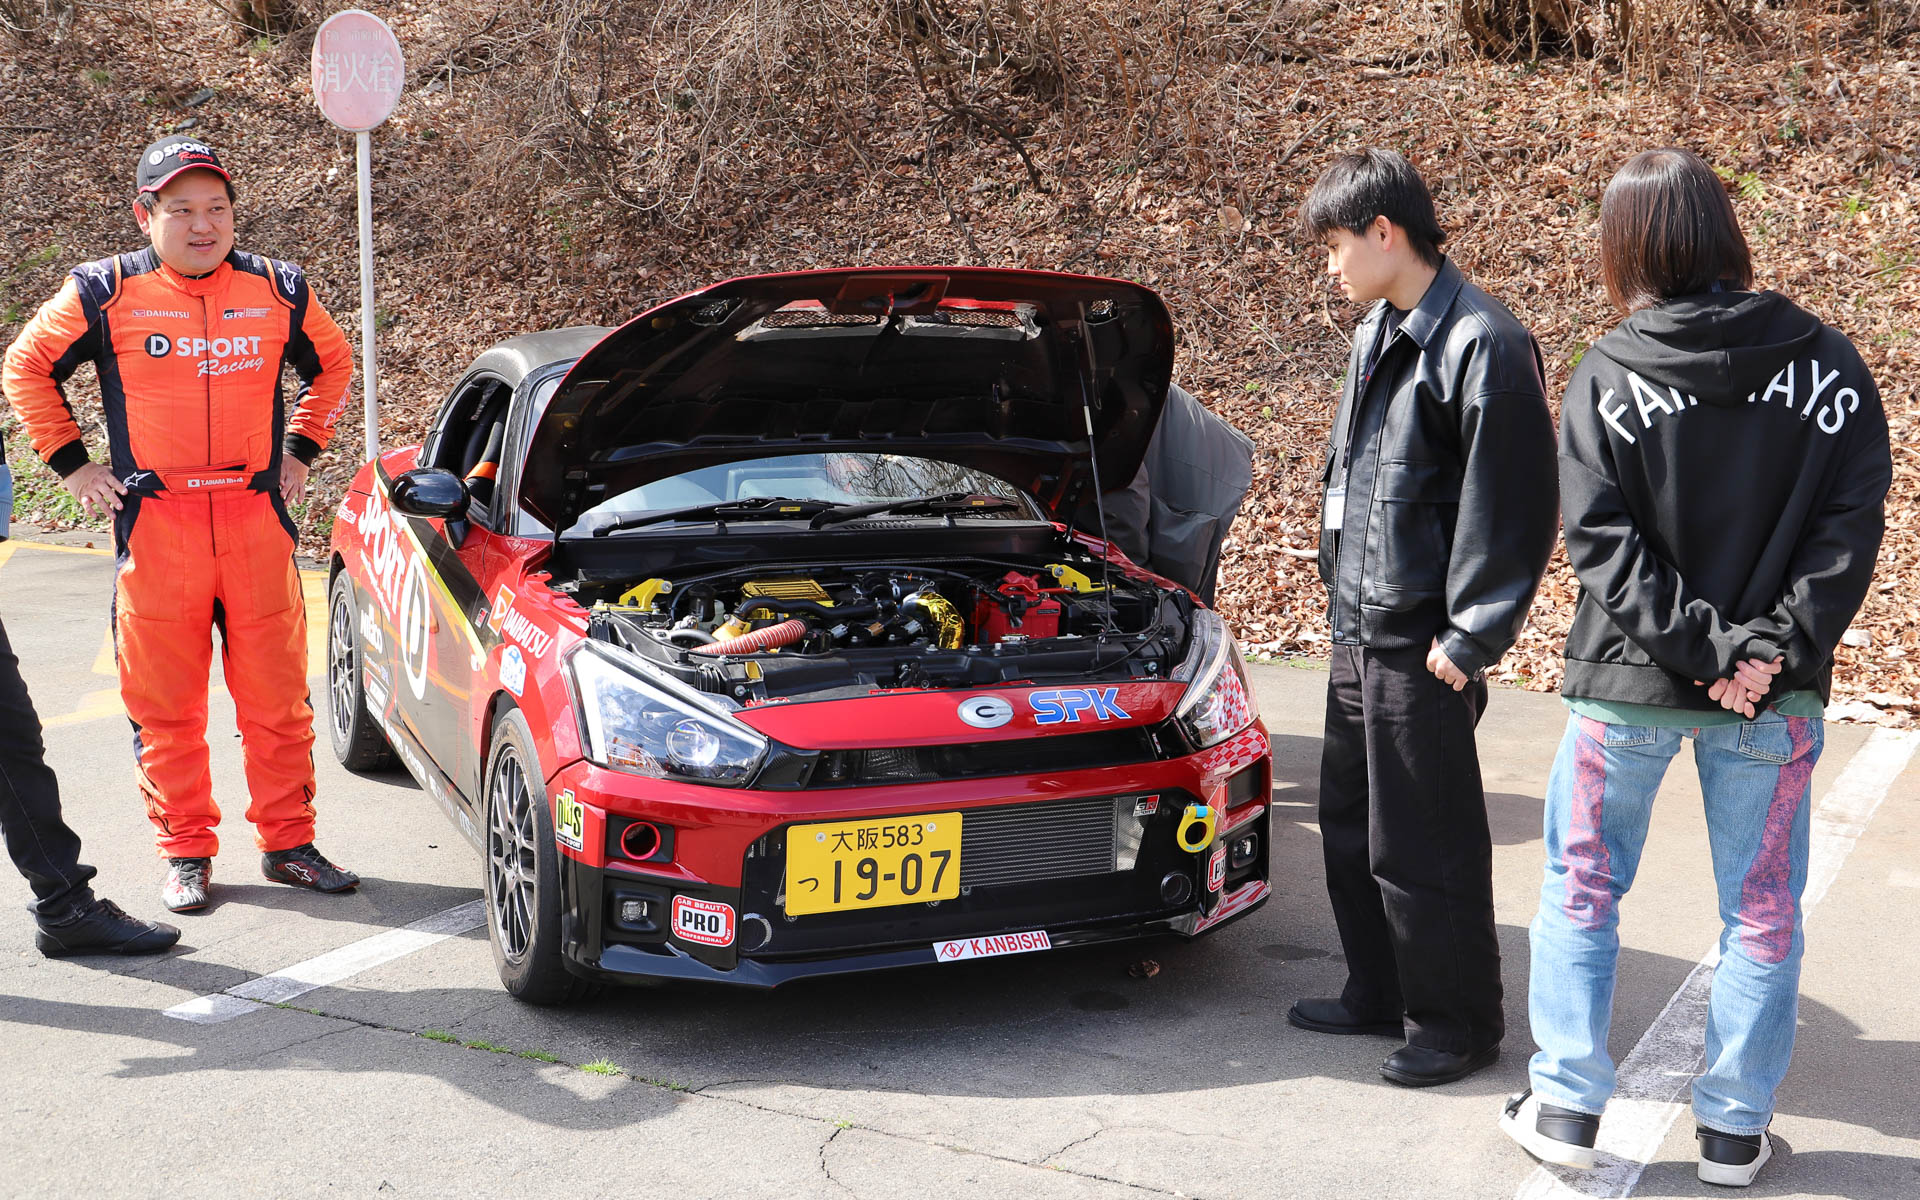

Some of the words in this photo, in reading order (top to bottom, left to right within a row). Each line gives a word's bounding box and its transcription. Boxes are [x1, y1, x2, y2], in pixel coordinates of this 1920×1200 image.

[316, 51, 395, 93] 消火栓
[164, 143, 210, 157] SPORT
[146, 309, 190, 319] DAIHATSU
[149, 335, 170, 356] D
[176, 336, 261, 357] SPORT
[197, 357, 264, 378] Racing
[358, 478, 406, 615] SPORT
[502, 607, 554, 659] DAIHATSU
[1028, 687, 1132, 725] SPK
[557, 790, 582, 838] DRS
[797, 877, 819, 893] つ
[833, 849, 952, 904] 19-07
[677, 897, 692, 906] CAR
[694, 901, 728, 913] BEAUTY
[682, 909, 720, 934] PRO
[969, 931, 1049, 956] KANBISHI
